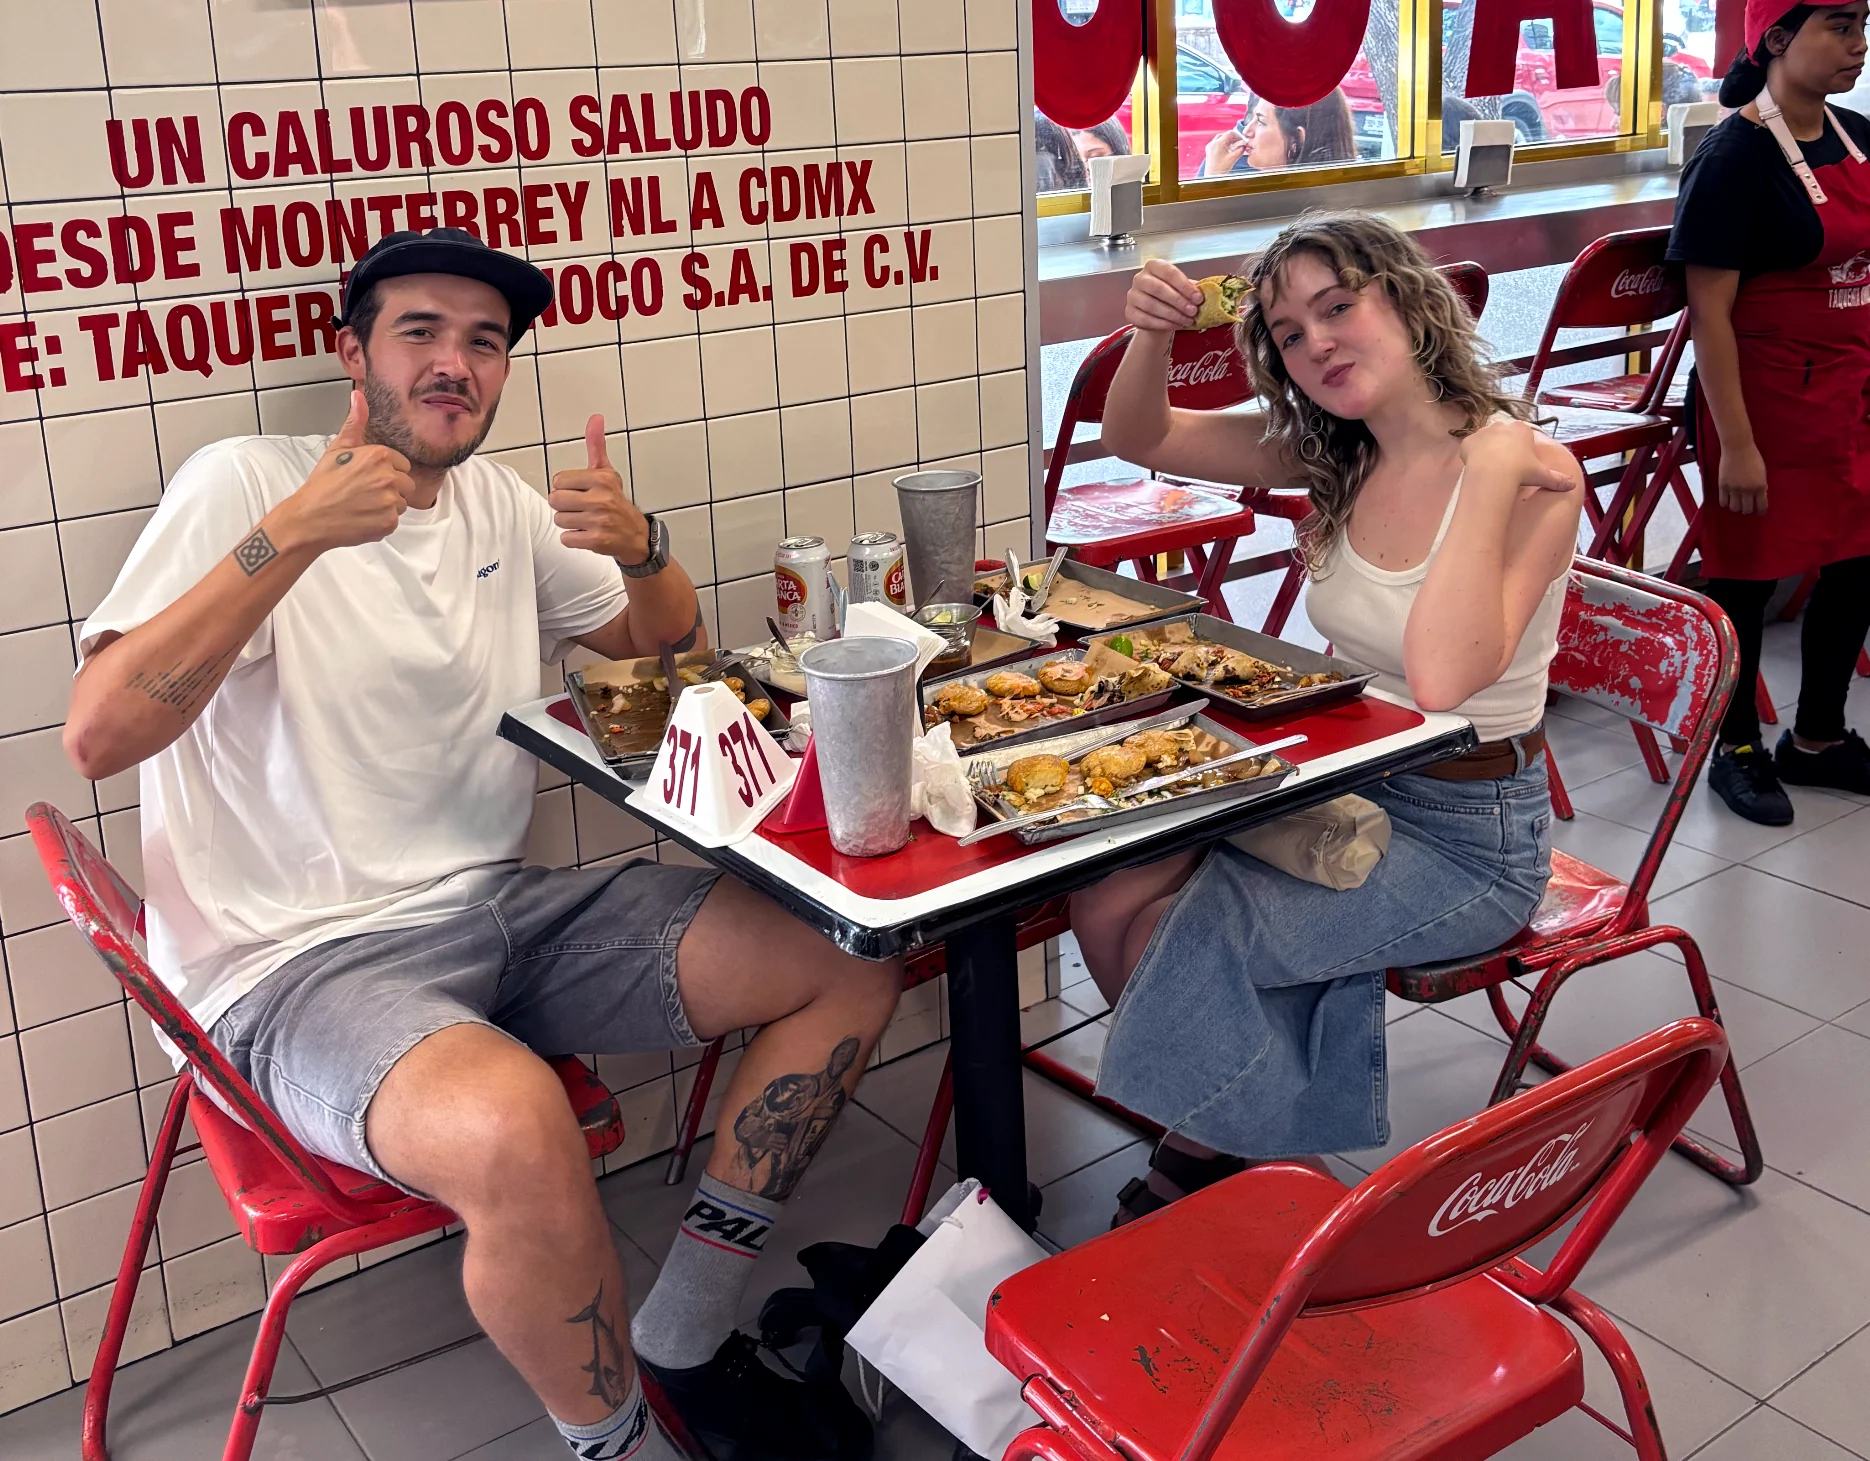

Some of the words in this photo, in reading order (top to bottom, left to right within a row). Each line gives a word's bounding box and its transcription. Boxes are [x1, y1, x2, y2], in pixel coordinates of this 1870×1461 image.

[106, 116, 205, 189] UN
[228, 98, 551, 181] CALUROSO
[570, 86, 771, 158] SALUDO
[220, 180, 590, 274] MONTERREY
[610, 175, 678, 238] NL
[690, 171, 725, 231] A
[739, 159, 876, 226] CDMX
[78, 290, 351, 382] TAQUER
[681, 247, 773, 311] S.A.
[790, 238, 849, 298] DE
[864, 229, 939, 291] C.V.
[1167, 346, 1237, 388] oca-Cola
[663, 724, 702, 817] 371
[718, 711, 777, 808] 371
[1427, 1116, 1596, 1237] Coca-Cola
